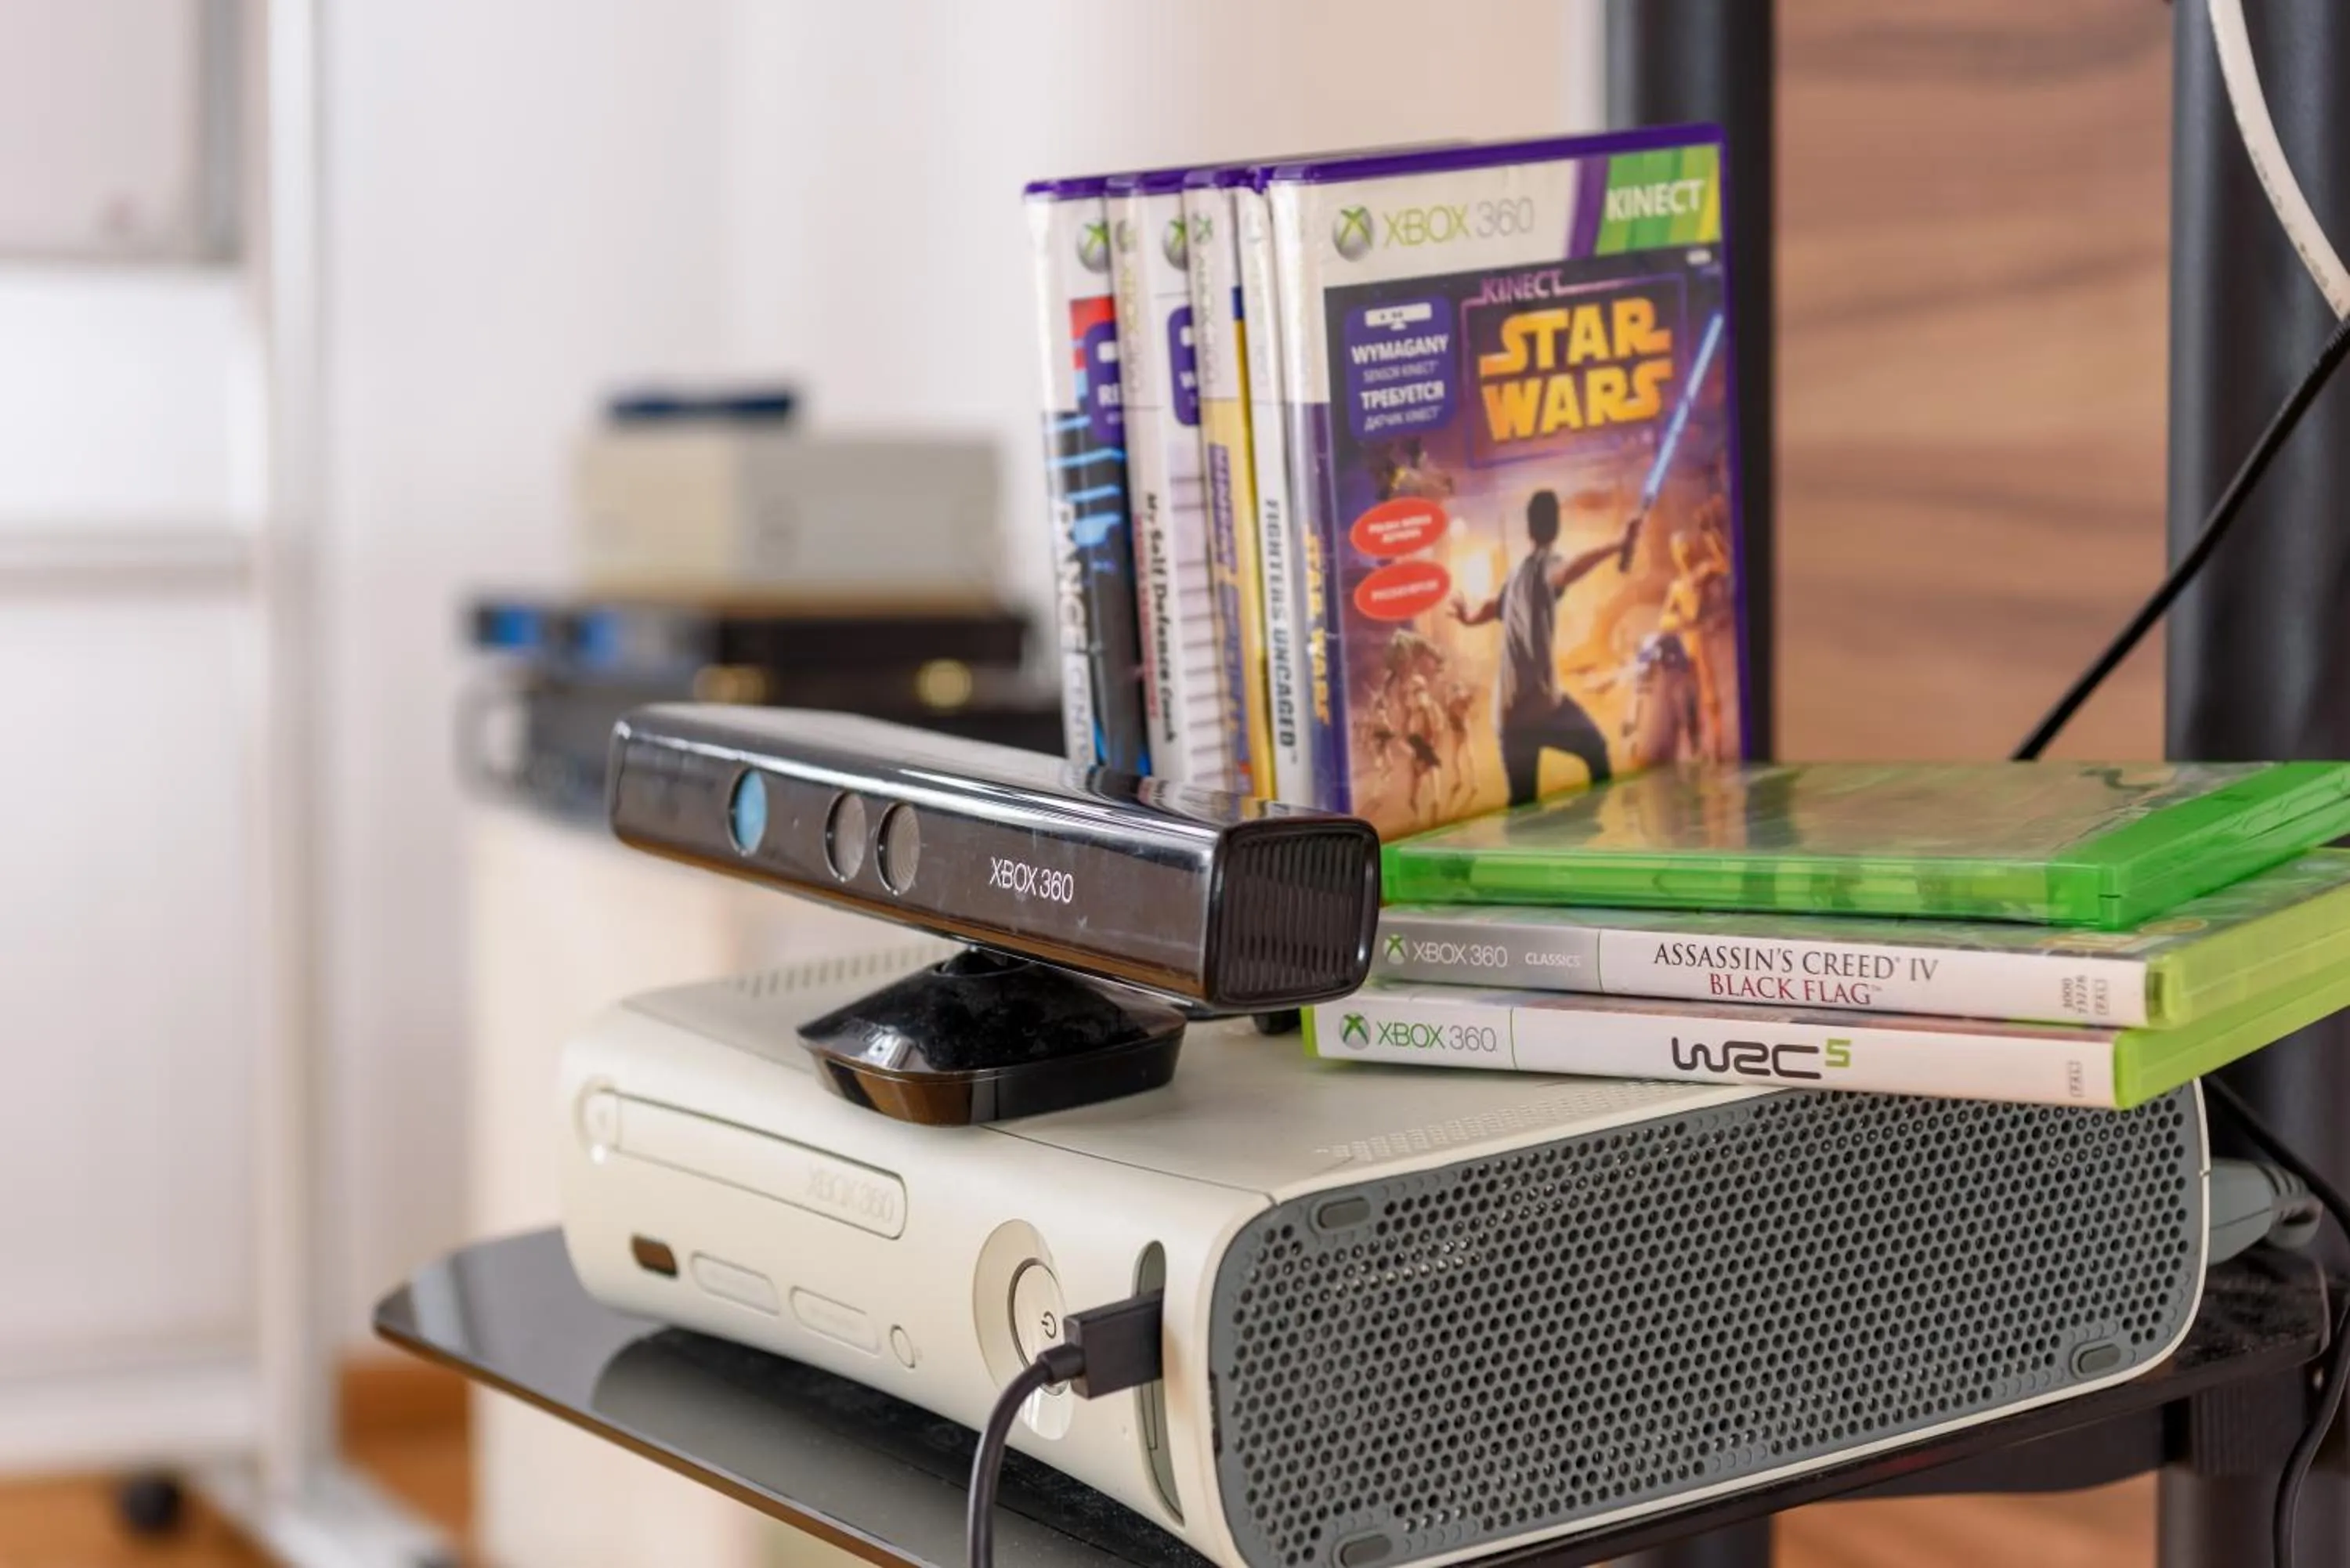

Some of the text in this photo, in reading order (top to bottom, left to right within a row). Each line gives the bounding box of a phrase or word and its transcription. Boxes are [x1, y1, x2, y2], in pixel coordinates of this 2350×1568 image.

[1382, 197, 1535, 248] XBOX 360
[1606, 179, 1706, 222] KINECT
[1481, 268, 1564, 304] KINECT
[1351, 334, 1448, 365] WYMAGANY
[1478, 297, 1672, 378] STAR
[1480, 357, 1673, 442] WARS
[1051, 499, 1087, 649] DANCE
[1152, 529, 1167, 576] Self
[1153, 583, 1171, 681] Defence
[1265, 499, 1296, 747] FIGHTERS UNCAGED
[1303, 524, 1330, 725] STAR WARS
[1161, 688, 1177, 743] Coach
[989, 857, 1074, 903] XBOX 360
[1413, 941, 1581, 968] XBOX 360 CLASSICS
[1654, 942, 1940, 981] ASSASSIN'S CREED IV
[1709, 973, 1871, 1006] BLACK FLAG
[1376, 1021, 1498, 1053] XBOX 360
